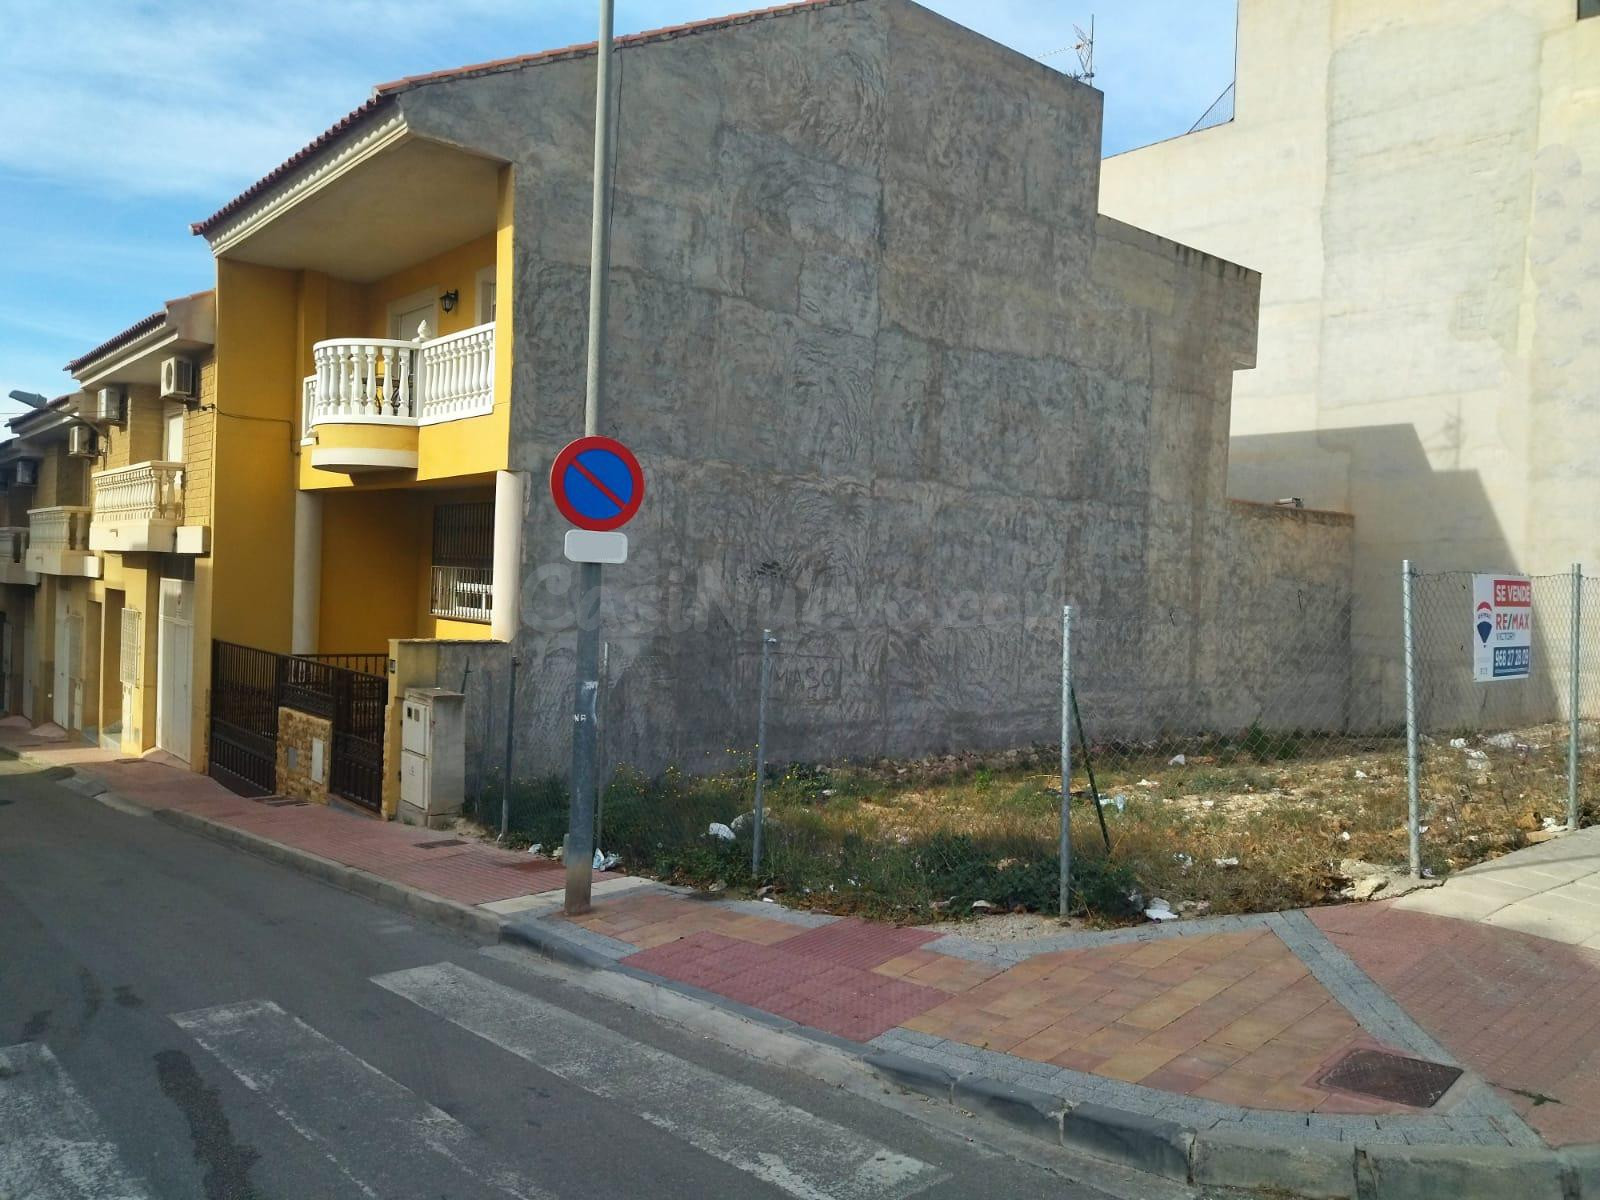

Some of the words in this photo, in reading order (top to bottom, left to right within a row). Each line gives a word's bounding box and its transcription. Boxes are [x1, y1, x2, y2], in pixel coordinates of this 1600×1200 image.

[1496, 584, 1506, 602] SE
[1507, 584, 1530, 602] VENDE
[1496, 613, 1529, 630] RE/MAX
[1507, 649, 1514, 666] 27
